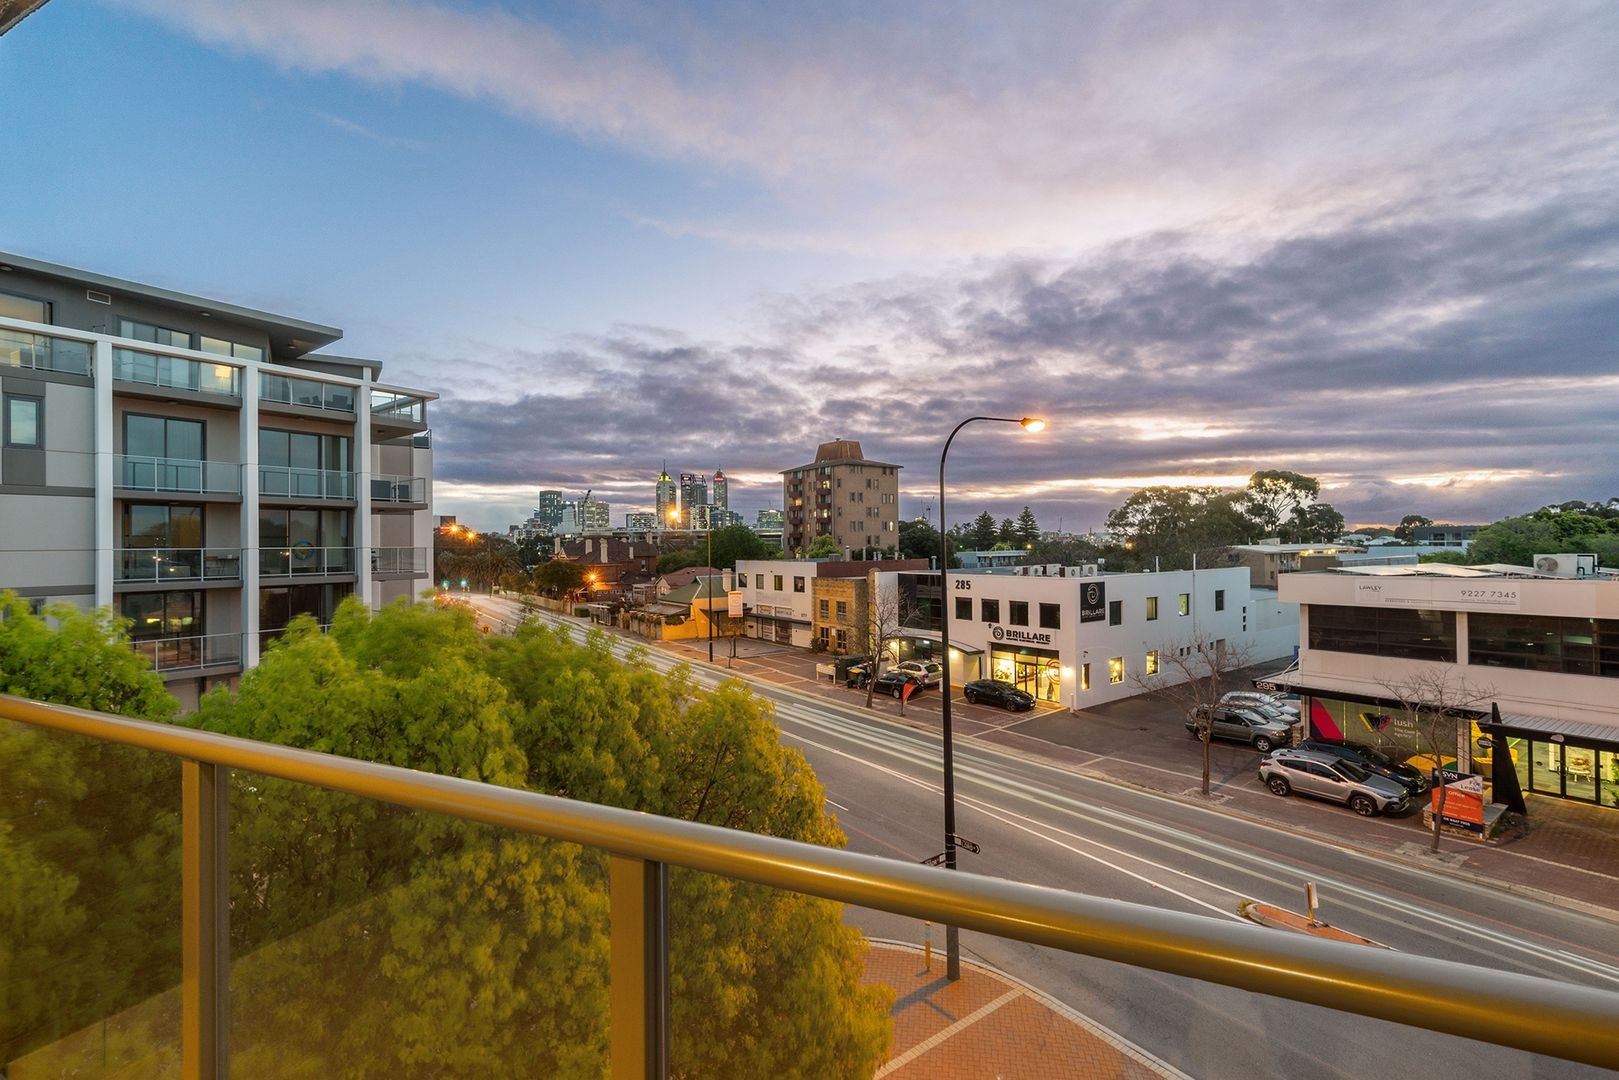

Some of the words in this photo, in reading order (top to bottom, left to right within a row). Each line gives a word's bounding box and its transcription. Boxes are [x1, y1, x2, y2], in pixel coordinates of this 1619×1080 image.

[955, 580, 971, 590] 285
[1460, 590, 1486, 598] 9227
[1490, 591, 1517, 599] 7345
[1006, 630, 1051, 643] BRILLARE
[1256, 681, 1276, 691] 295
[1394, 717, 1414, 729] lush
